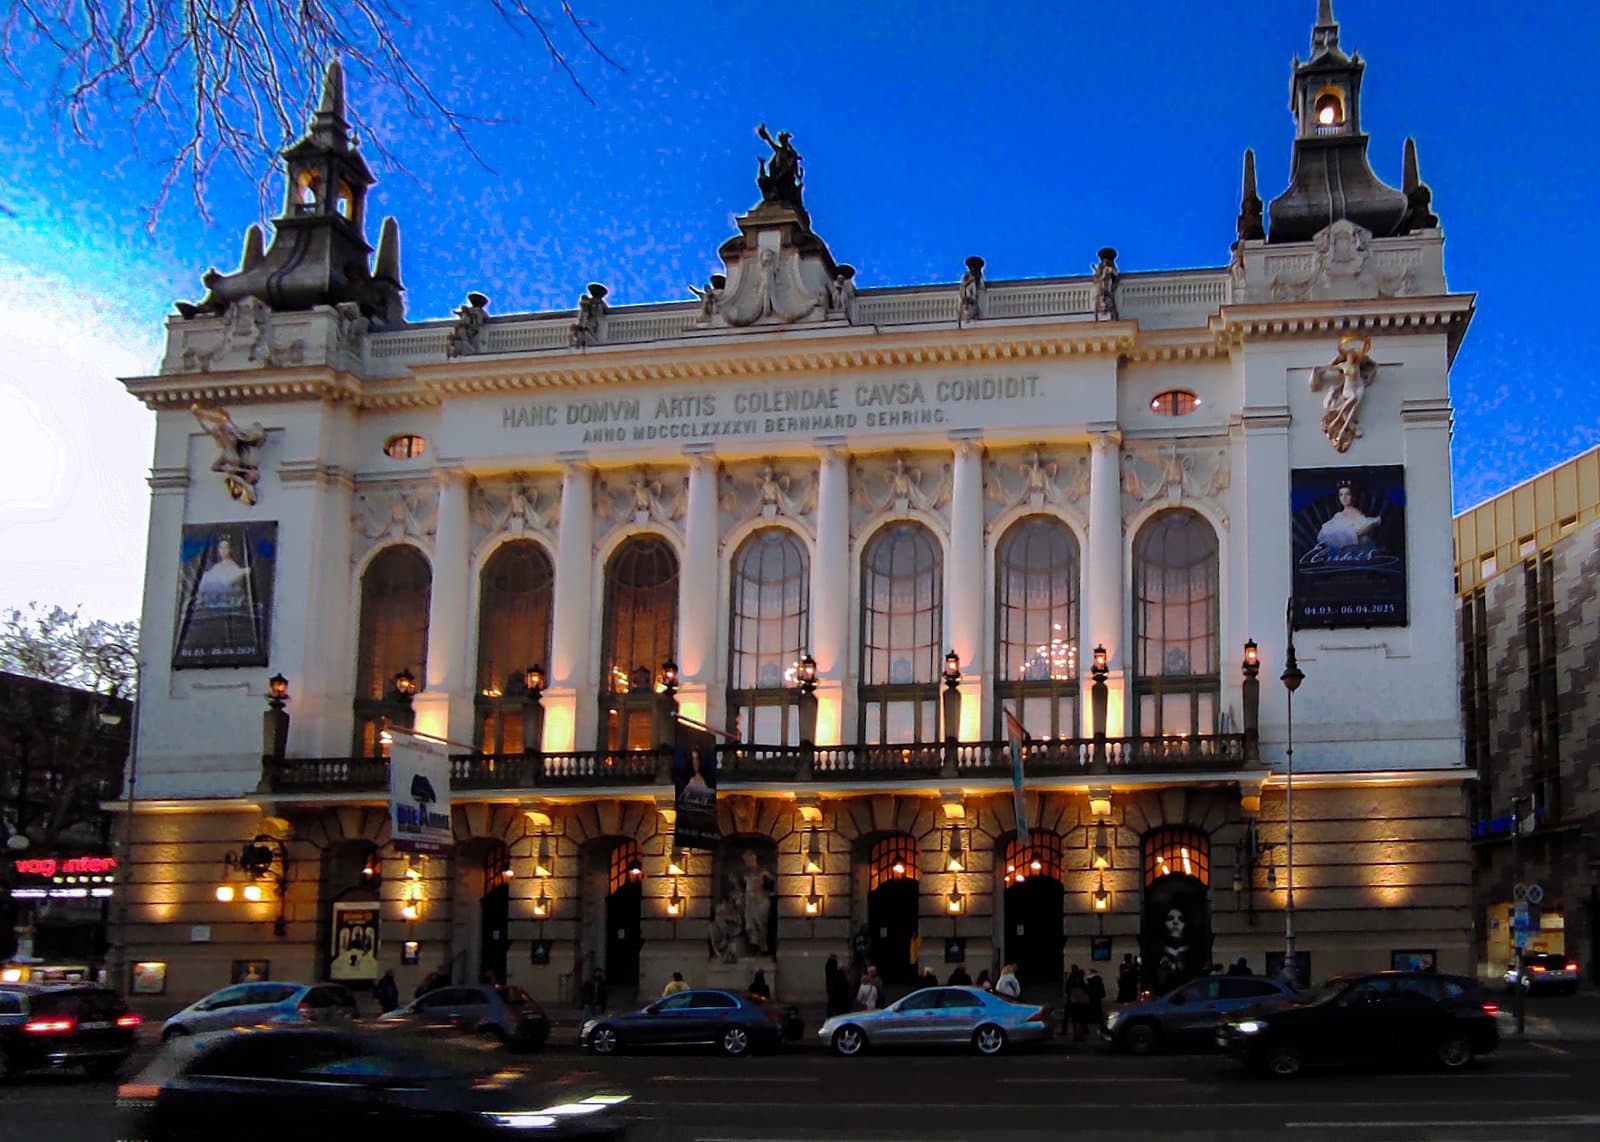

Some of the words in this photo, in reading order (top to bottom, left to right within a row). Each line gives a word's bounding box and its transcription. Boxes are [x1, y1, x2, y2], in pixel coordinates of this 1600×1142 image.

[503, 405, 557, 428] HANC
[566, 399, 641, 425] DOMVM
[654, 394, 716, 419] ARTIS
[733, 387, 839, 414] COLENDAE
[855, 381, 925, 407] CAVSA
[936, 376, 1045, 402] CONDIDIT.
[582, 426, 626, 443] ANNO
[632, 418, 757, 440] MDCCCLXXXXVI
[764, 412, 857, 432] BERNHARD
